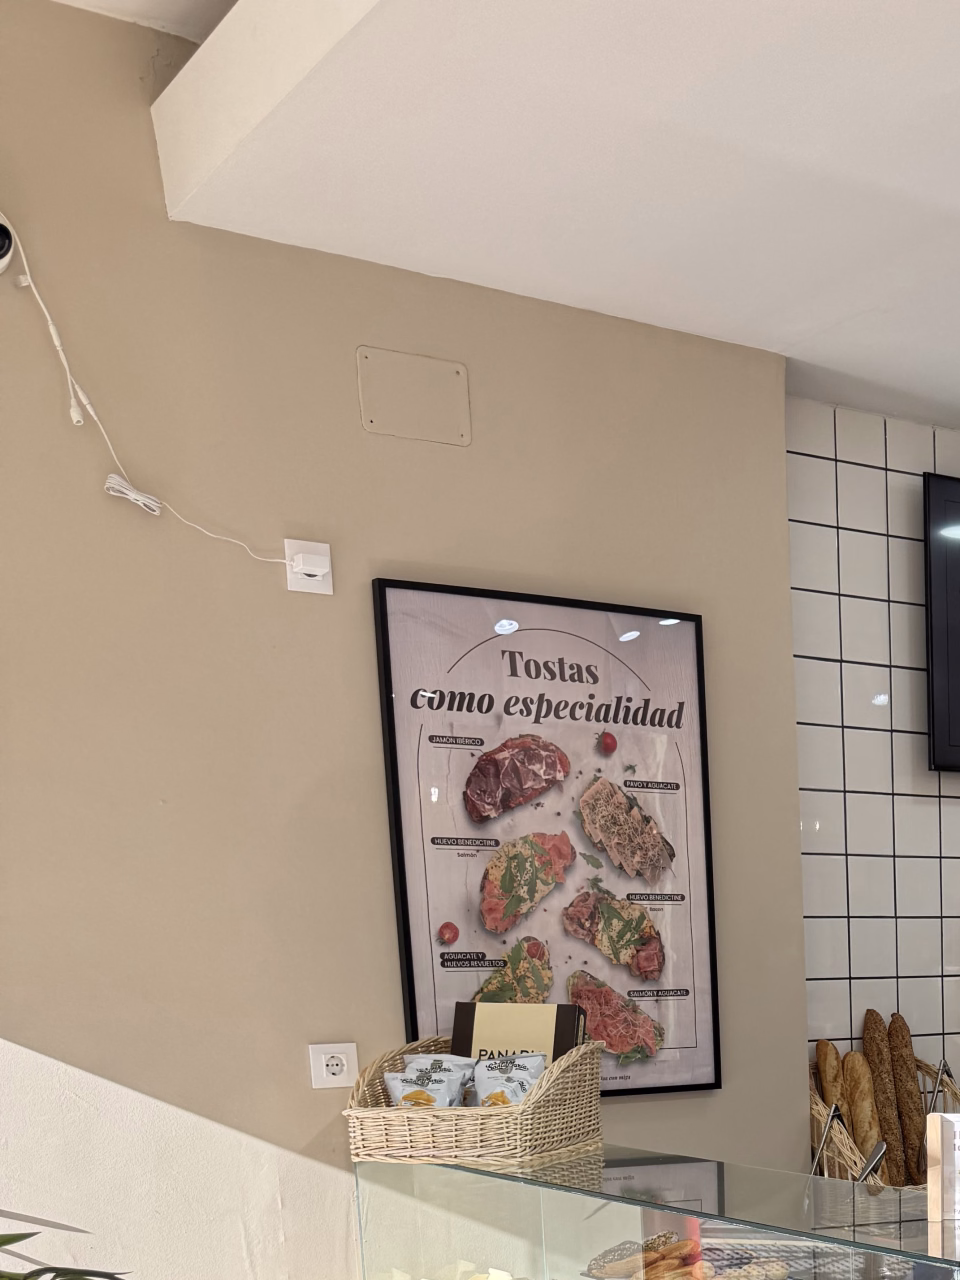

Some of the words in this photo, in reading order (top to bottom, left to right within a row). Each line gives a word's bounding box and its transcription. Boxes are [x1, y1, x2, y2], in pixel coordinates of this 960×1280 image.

[501, 649, 599, 685] Tostas
[410, 687, 495, 715] como
[503, 692, 685, 730] especialidad
[432, 736, 456, 744] JAMÓN
[456, 737, 481, 746] IBÉRICO
[626, 780, 642, 788] PAVO
[647, 782, 677, 790] AGUACATE
[457, 838, 496, 847] BENEDICTINE
[630, 989, 653, 997] SALMÓN
[658, 989, 687, 997] AGUACATE
